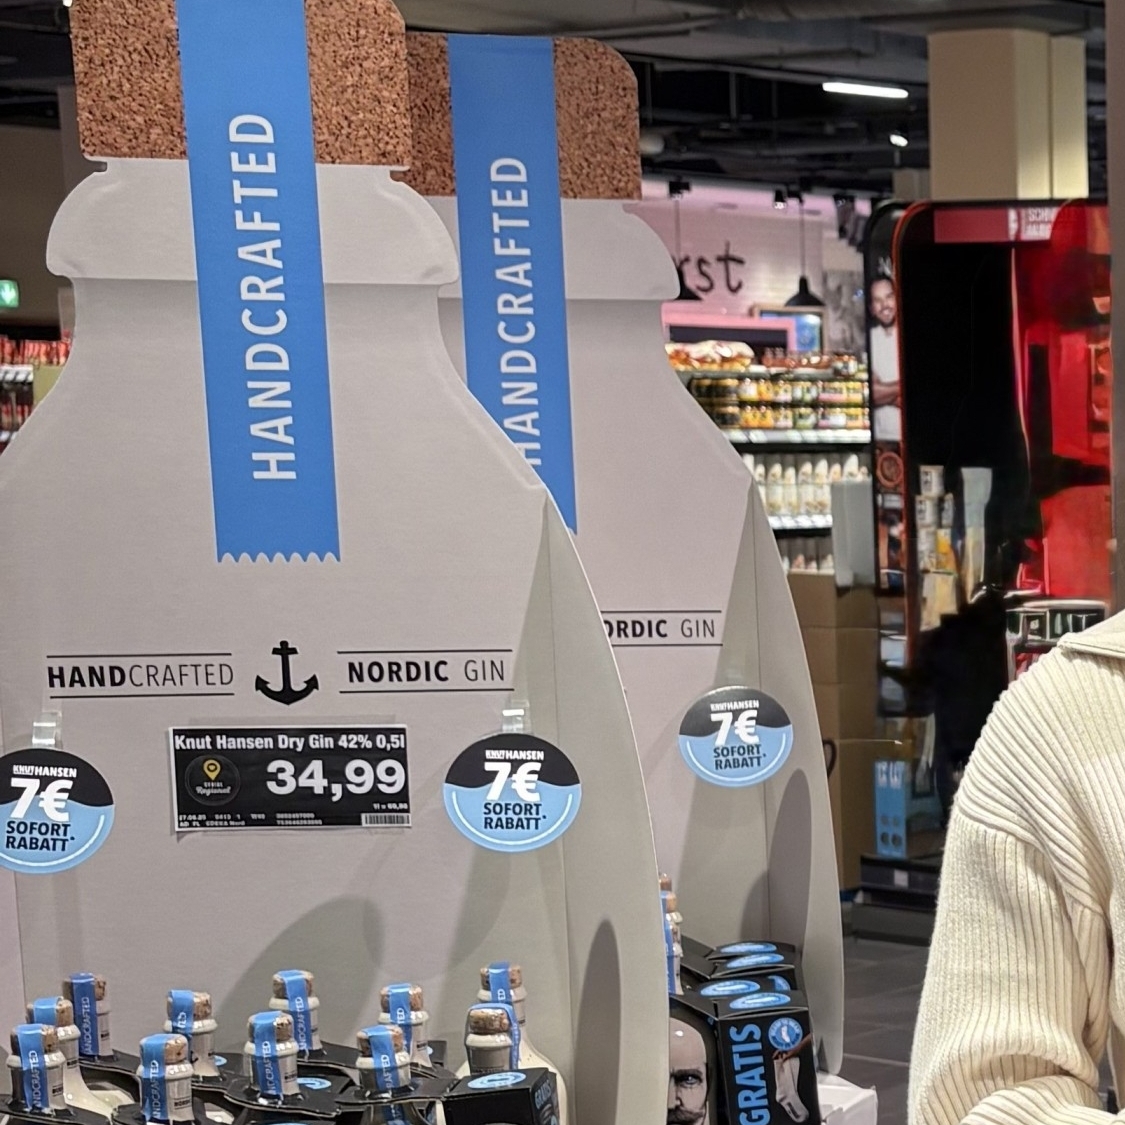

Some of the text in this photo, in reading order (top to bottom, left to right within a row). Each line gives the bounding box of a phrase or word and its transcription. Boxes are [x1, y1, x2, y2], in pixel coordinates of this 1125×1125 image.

[671, 240, 745, 294] rst
[229, 113, 297, 480] HANDCRAFTED
[601, 618, 716, 639] ORDIC GIN
[47, 663, 234, 689] HANDCRAFTED
[347, 658, 505, 683] NORDIC GIN
[175, 733, 405, 752] Knut Hansen Dry Gin 42% 0,5l
[710, 709, 760, 746] 7€
[713, 743, 762, 759] SOFORT
[266, 758, 407, 802] 34,99
[483, 761, 541, 803] 7€
[10, 778, 74, 822] 7€
[483, 802, 543, 818] SOFORT
[6, 820, 71, 838] SOFORT
[28, 1049, 42, 1108] ANDCRAFTED
[150, 1059, 162, 1119] ANDCRAFTED
